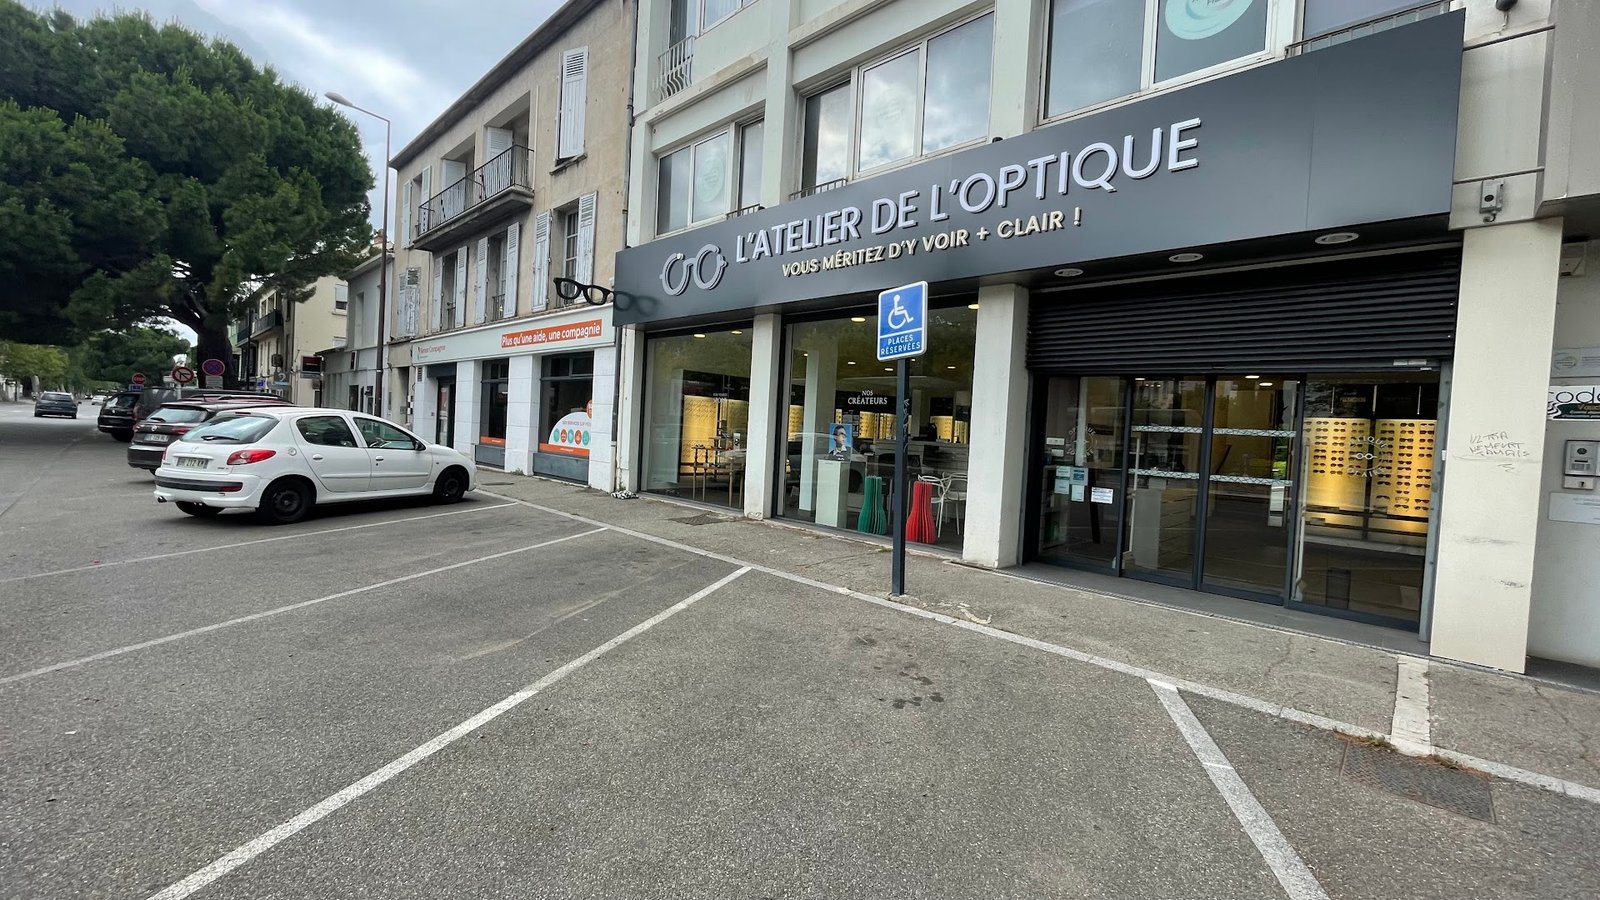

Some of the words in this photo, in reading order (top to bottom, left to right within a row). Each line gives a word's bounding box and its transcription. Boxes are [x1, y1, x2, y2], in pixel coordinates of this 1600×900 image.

[735, 205, 862, 264] L'ATELIER
[871, 189, 919, 236] DE
[930, 117, 1203, 223] L'OPTIQUE
[781, 258, 819, 278] VOUS
[822, 243, 883, 272] MÉRITEZ
[888, 239, 916, 261] D'Y
[921, 228, 968, 254] VOIR
[997, 211, 1064, 239] CLAIR
[502, 335, 512, 345] Plus
[513, 334, 532, 346] qu'une
[532, 331, 548, 343] aide,
[549, 331, 560, 339] une
[562, 323, 601, 339] compagnie
[887, 335, 914, 345] PLACES
[881, 341, 921, 355] RÉSERVÉES
[847, 395, 887, 405] CRÉATEURS
